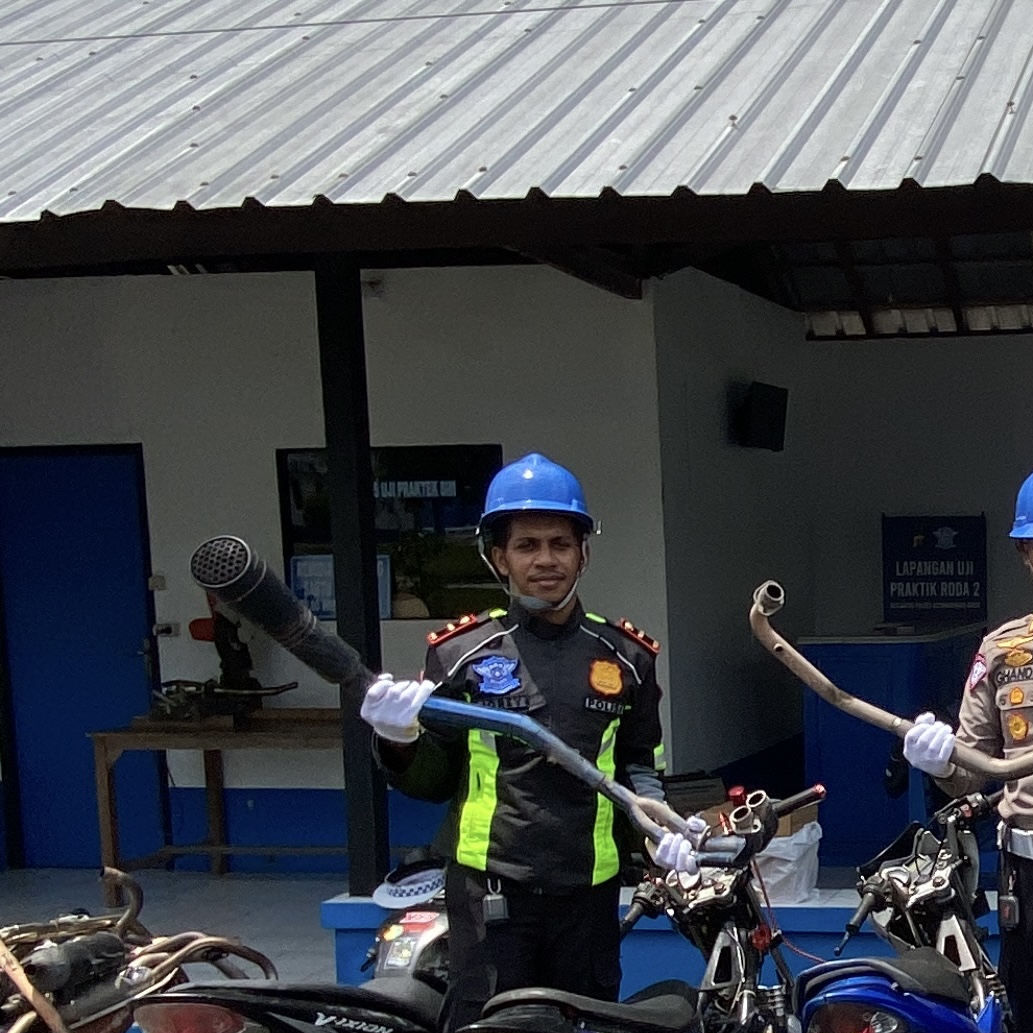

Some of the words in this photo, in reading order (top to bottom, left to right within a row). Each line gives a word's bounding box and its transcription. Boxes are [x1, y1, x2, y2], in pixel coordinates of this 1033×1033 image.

[896, 560, 955, 576] LAPANGAN
[957, 560, 974, 576] UJI
[890, 581, 938, 597] PRAKTIK
[940, 581, 970, 597] RODA
[973, 581, 980, 597] 2
